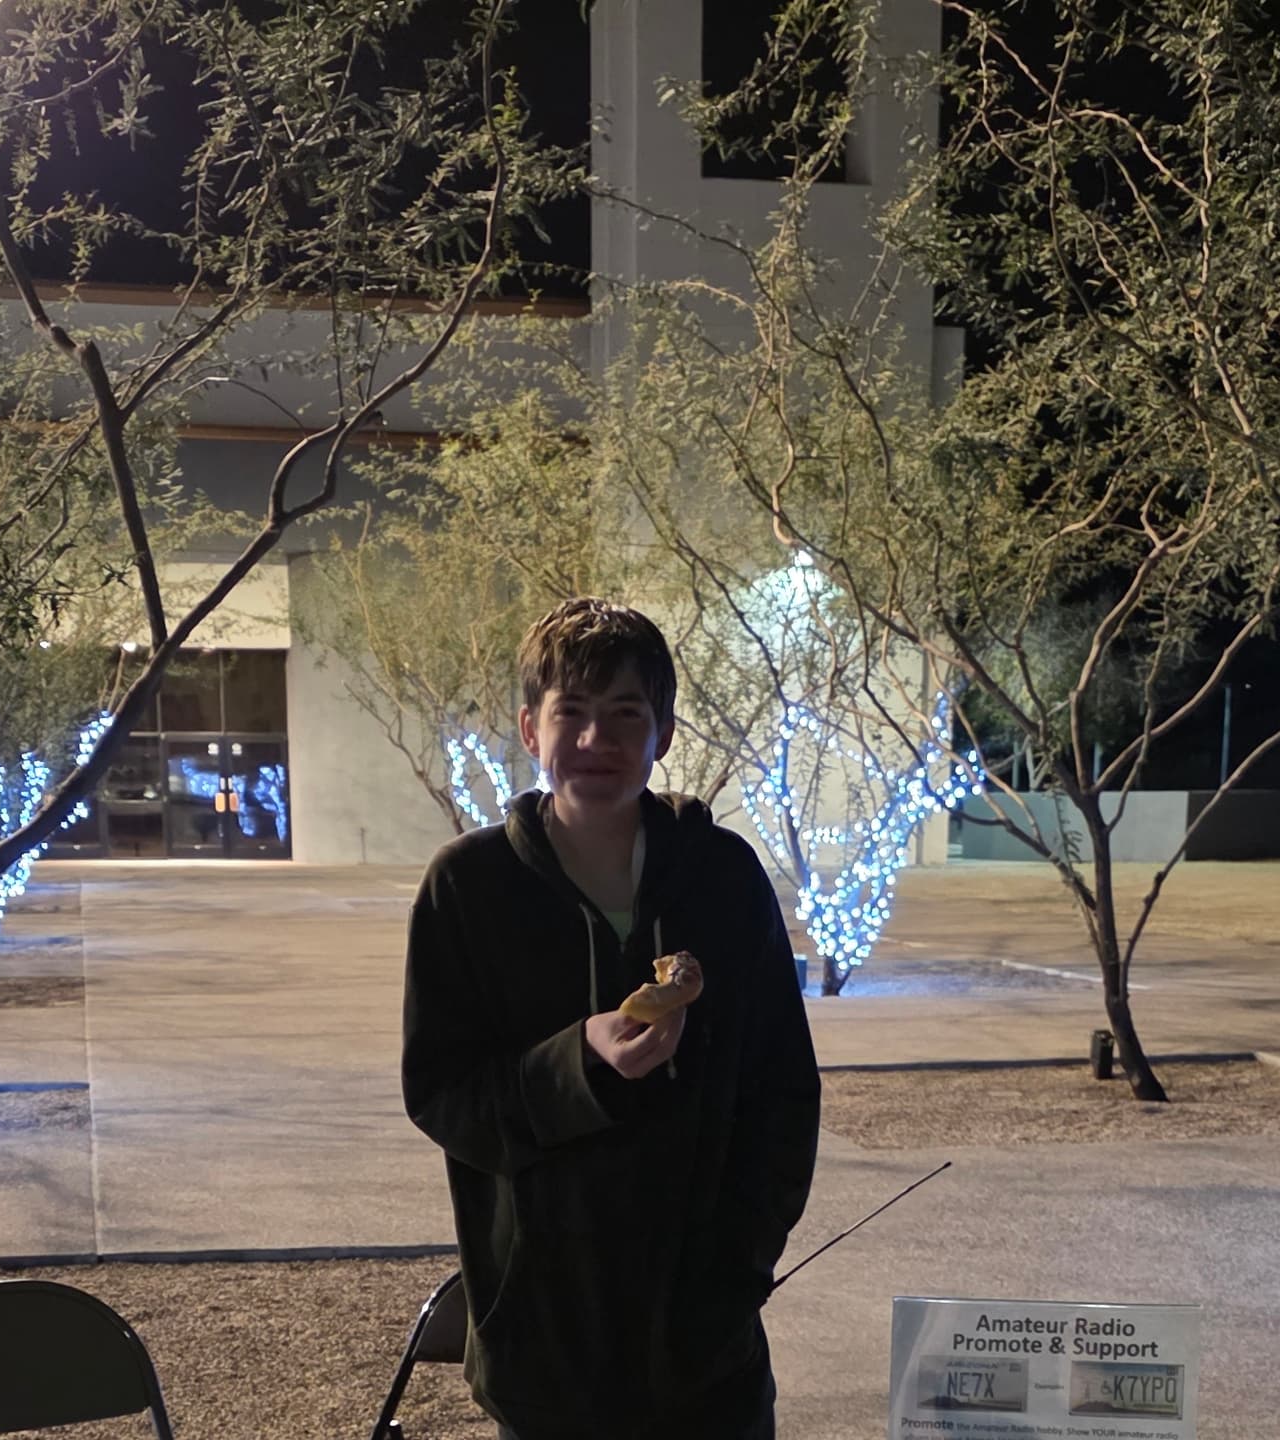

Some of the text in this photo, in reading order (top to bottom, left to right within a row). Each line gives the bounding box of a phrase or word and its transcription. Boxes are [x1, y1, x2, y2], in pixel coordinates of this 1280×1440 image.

[976, 1315, 1135, 1336] Amateur Radio
[953, 1334, 1158, 1360] Promote & Support
[947, 1371, 995, 1399] NE7X
[901, 1417, 954, 1430] Promote
[1067, 1428, 1090, 1436] Show
[1092, 1429, 1116, 1437] YOUR
[1118, 1431, 1154, 1439] amateur
[1156, 1432, 1179, 1440] radio
